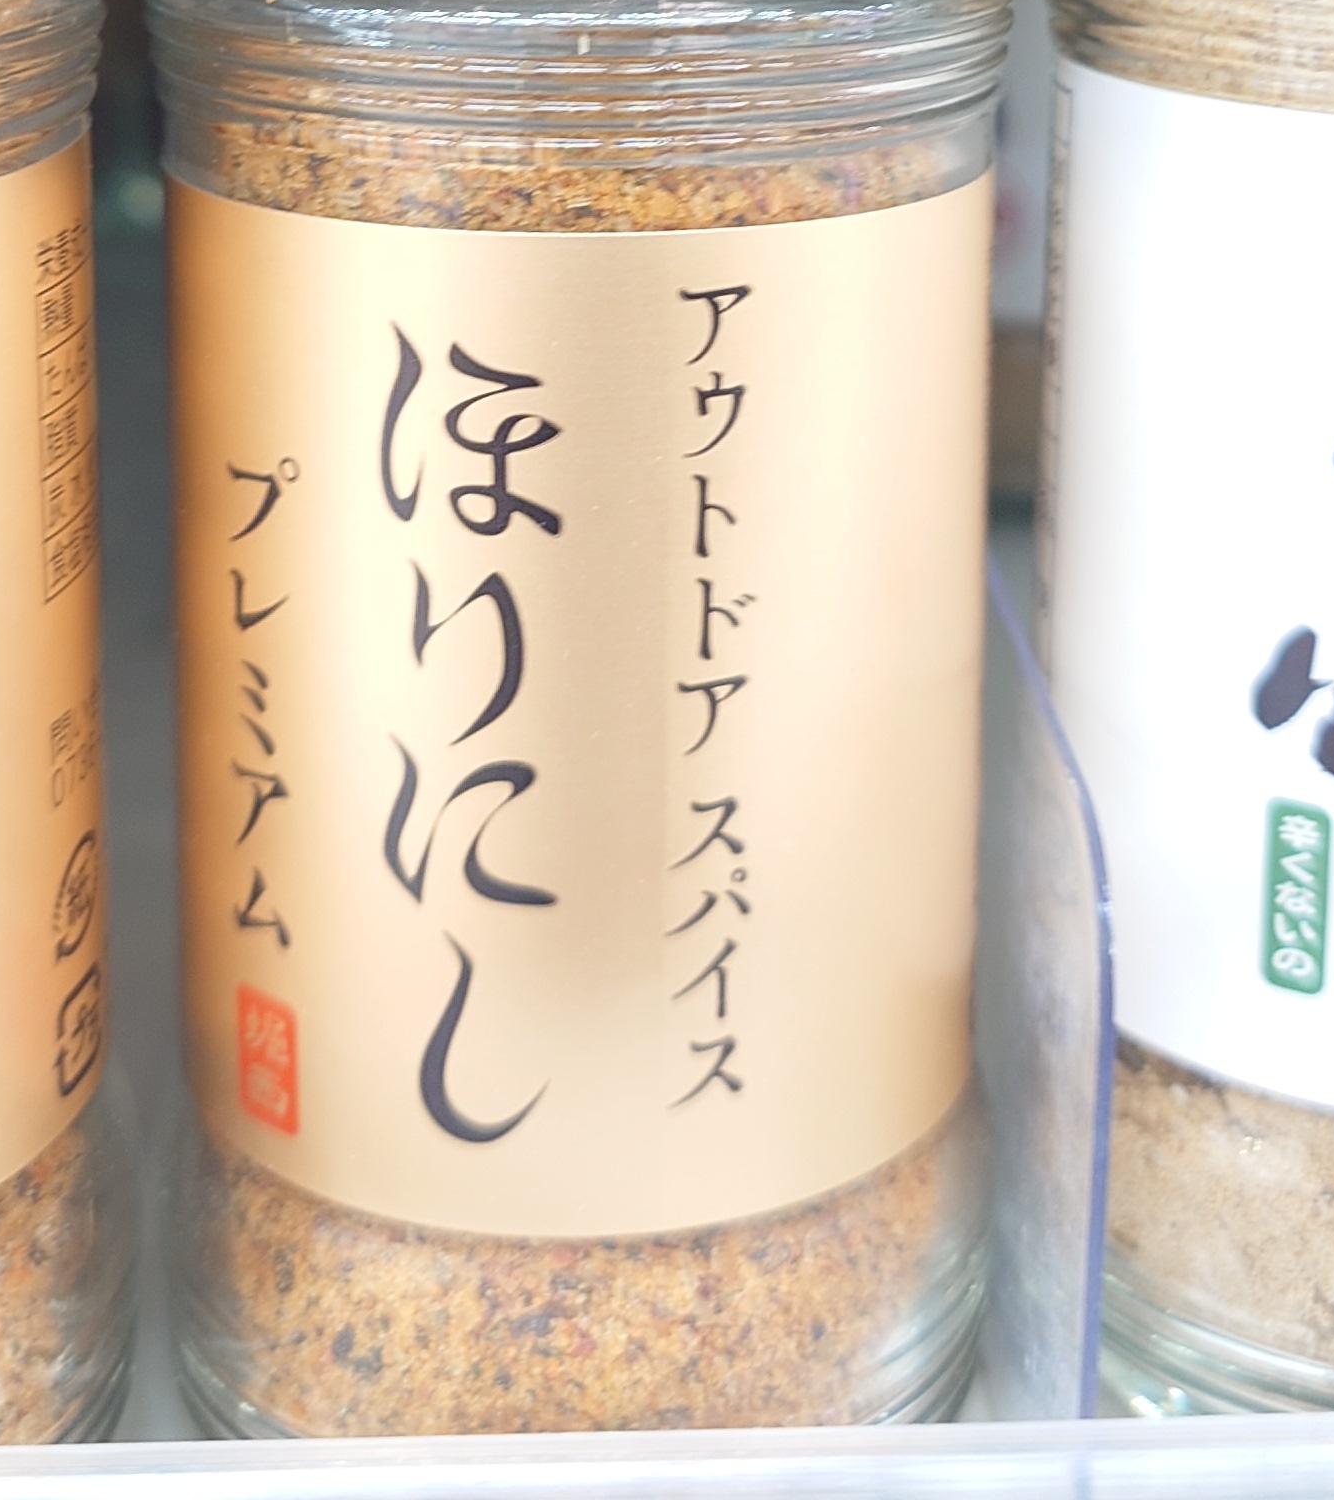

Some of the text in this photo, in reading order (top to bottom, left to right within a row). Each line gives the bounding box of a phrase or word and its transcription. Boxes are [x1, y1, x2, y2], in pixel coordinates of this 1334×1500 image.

[226, 455, 301, 953] プレミアム
[379, 318, 565, 1144] ほりにし
[665, 284, 756, 1110] アウトドア スパイス
[1270, 813, 1322, 979] 辛くないの
